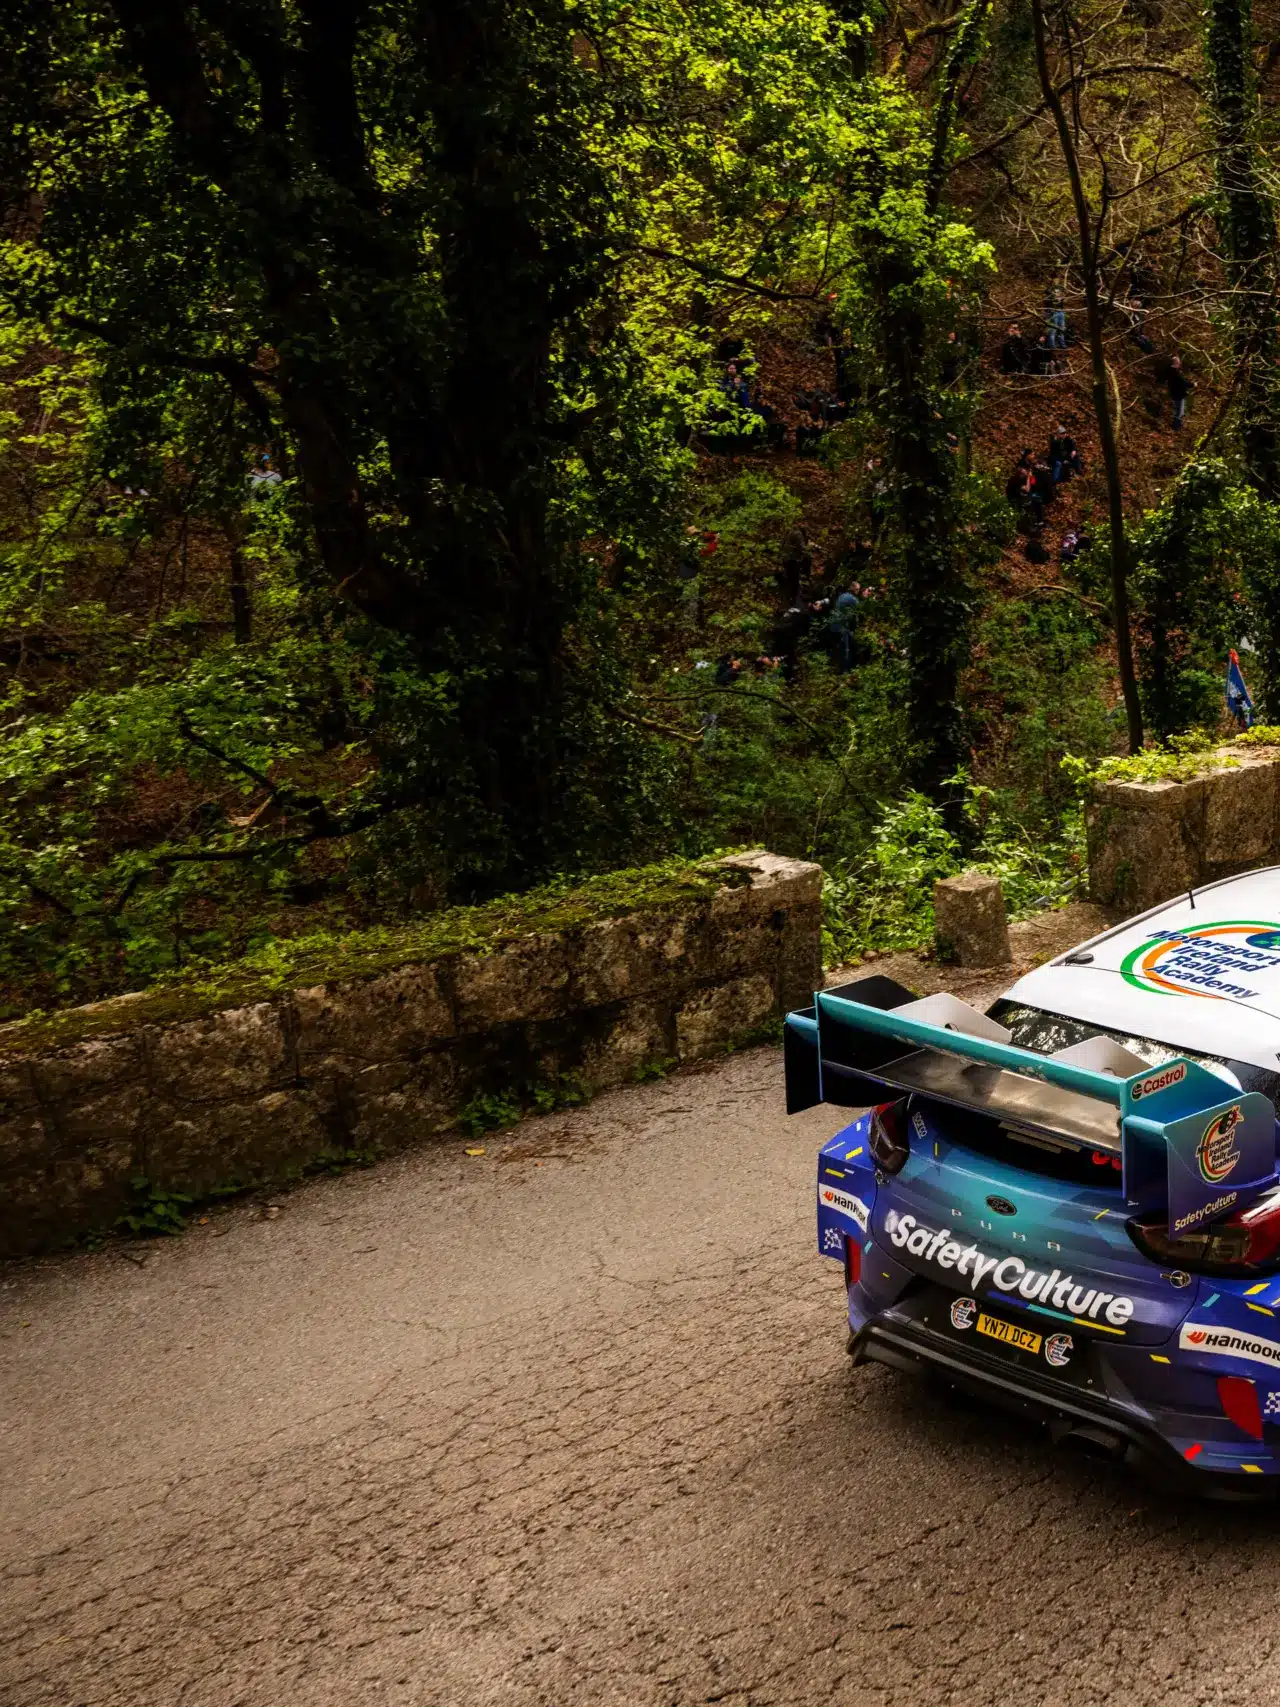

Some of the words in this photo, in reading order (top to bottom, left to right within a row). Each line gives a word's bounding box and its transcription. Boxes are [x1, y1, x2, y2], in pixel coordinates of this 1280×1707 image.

[1168, 955, 1229, 976] Rally
[1171, 945, 1269, 973] Ireland
[1146, 965, 1259, 999] Academy
[1143, 1065, 1184, 1094] Castrol
[1174, 1191, 1237, 1231] SafetyCulture
[892, 1213, 1134, 1325] SafetyCulture
[984, 1315, 1009, 1340] YN71
[1012, 1329, 1035, 1350] DCZ
